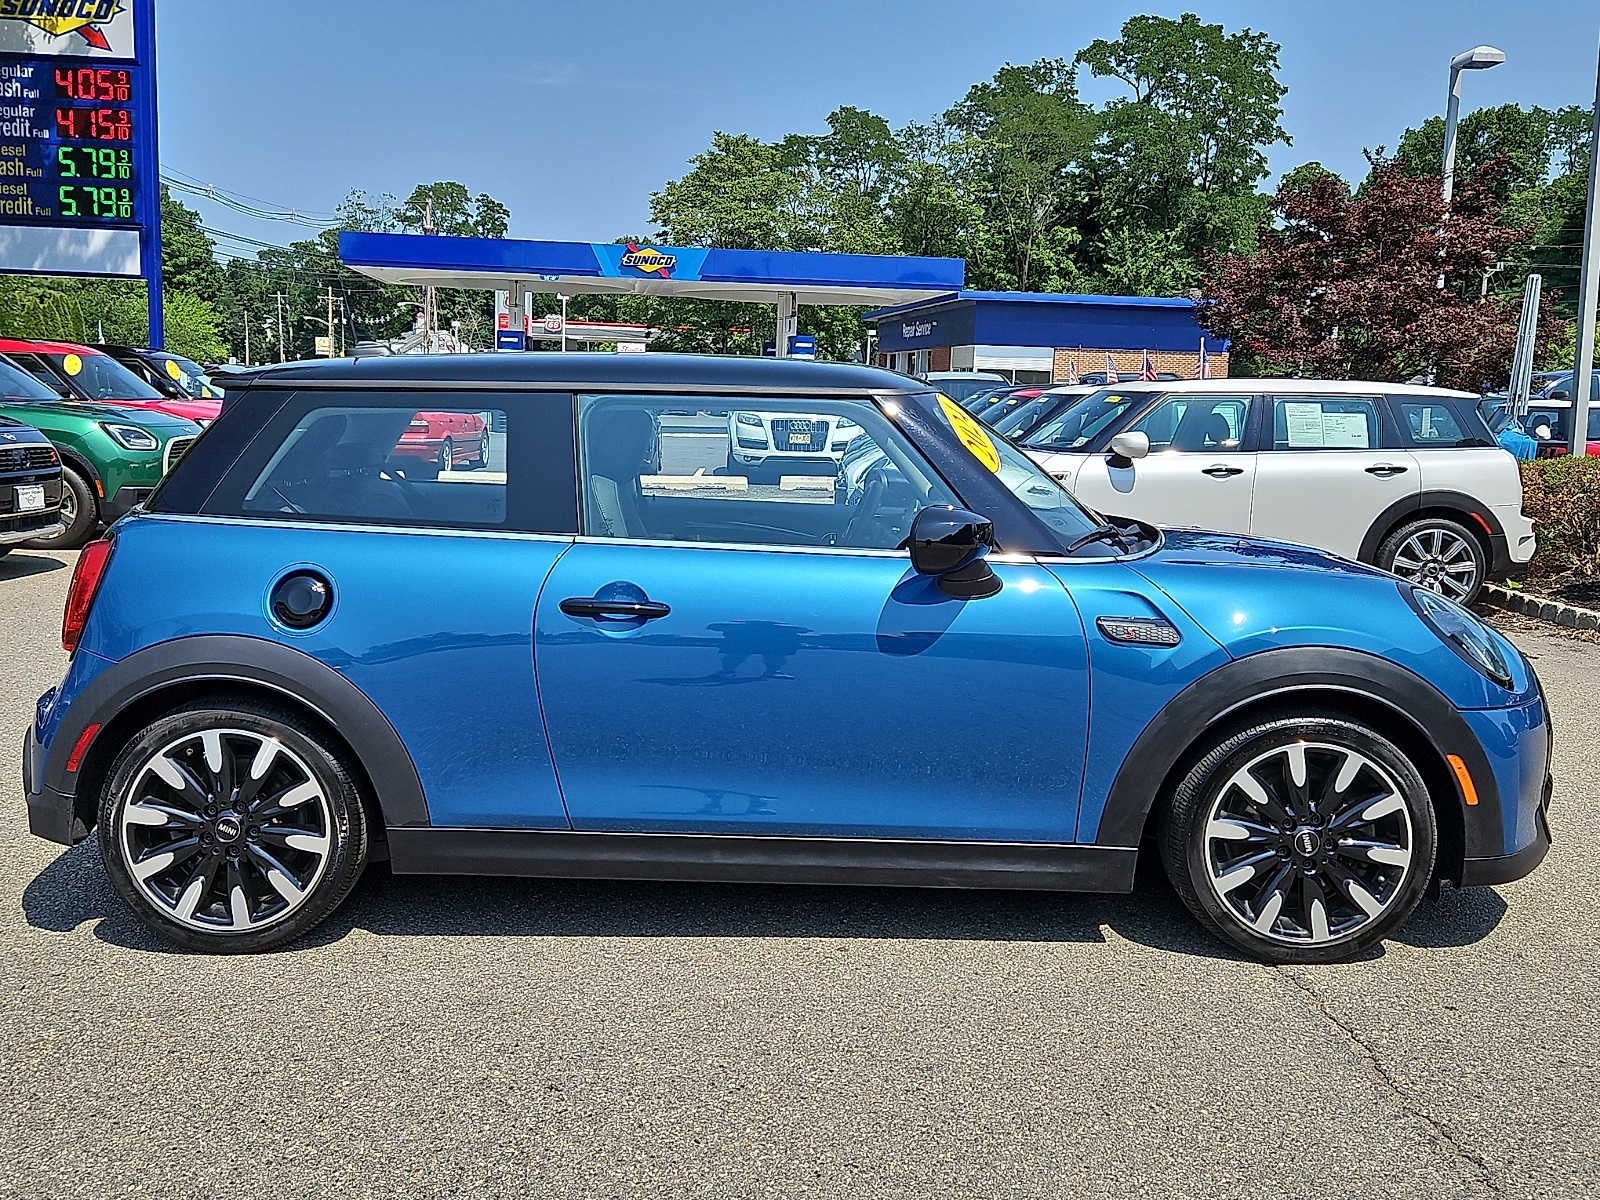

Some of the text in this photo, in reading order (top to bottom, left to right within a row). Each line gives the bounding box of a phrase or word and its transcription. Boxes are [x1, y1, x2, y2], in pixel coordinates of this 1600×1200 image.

[0, 0, 114, 19] SUNOCO
[0, 64, 33, 79] gular
[55, 69, 114, 100] 4.05
[23, 88, 39, 98] Full
[57, 109, 115, 139] 4.15
[33, 129, 49, 138] Full
[58, 147, 116, 178] 5.79
[26, 168, 42, 177] Full
[60, 186, 117, 217] 5.79
[35, 207, 51, 216] Full
[624, 254, 674, 266] SUNOCO
[217, 823, 237, 836] MINI
[1302, 834, 1312, 852] MINI
